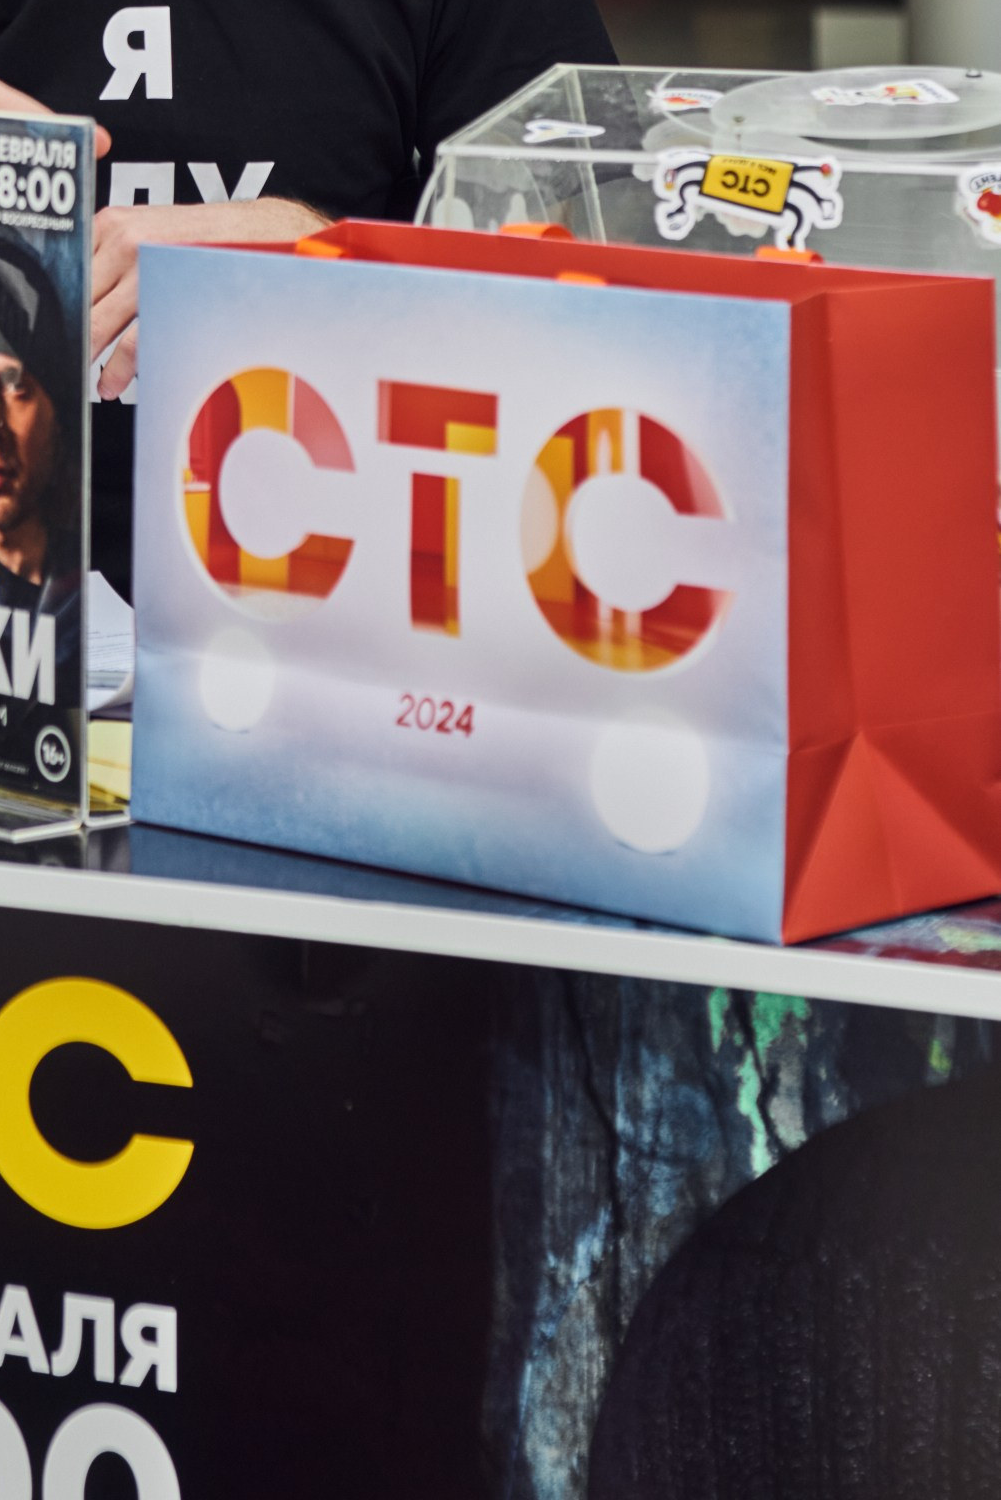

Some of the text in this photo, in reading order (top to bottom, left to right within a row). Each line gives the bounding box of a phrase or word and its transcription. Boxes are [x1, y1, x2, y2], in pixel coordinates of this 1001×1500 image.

[99, 6, 173, 100] Я
[721, 170, 771, 198] СТС
[175, 365, 737, 676] СТС
[396, 693, 475, 738] 2024
